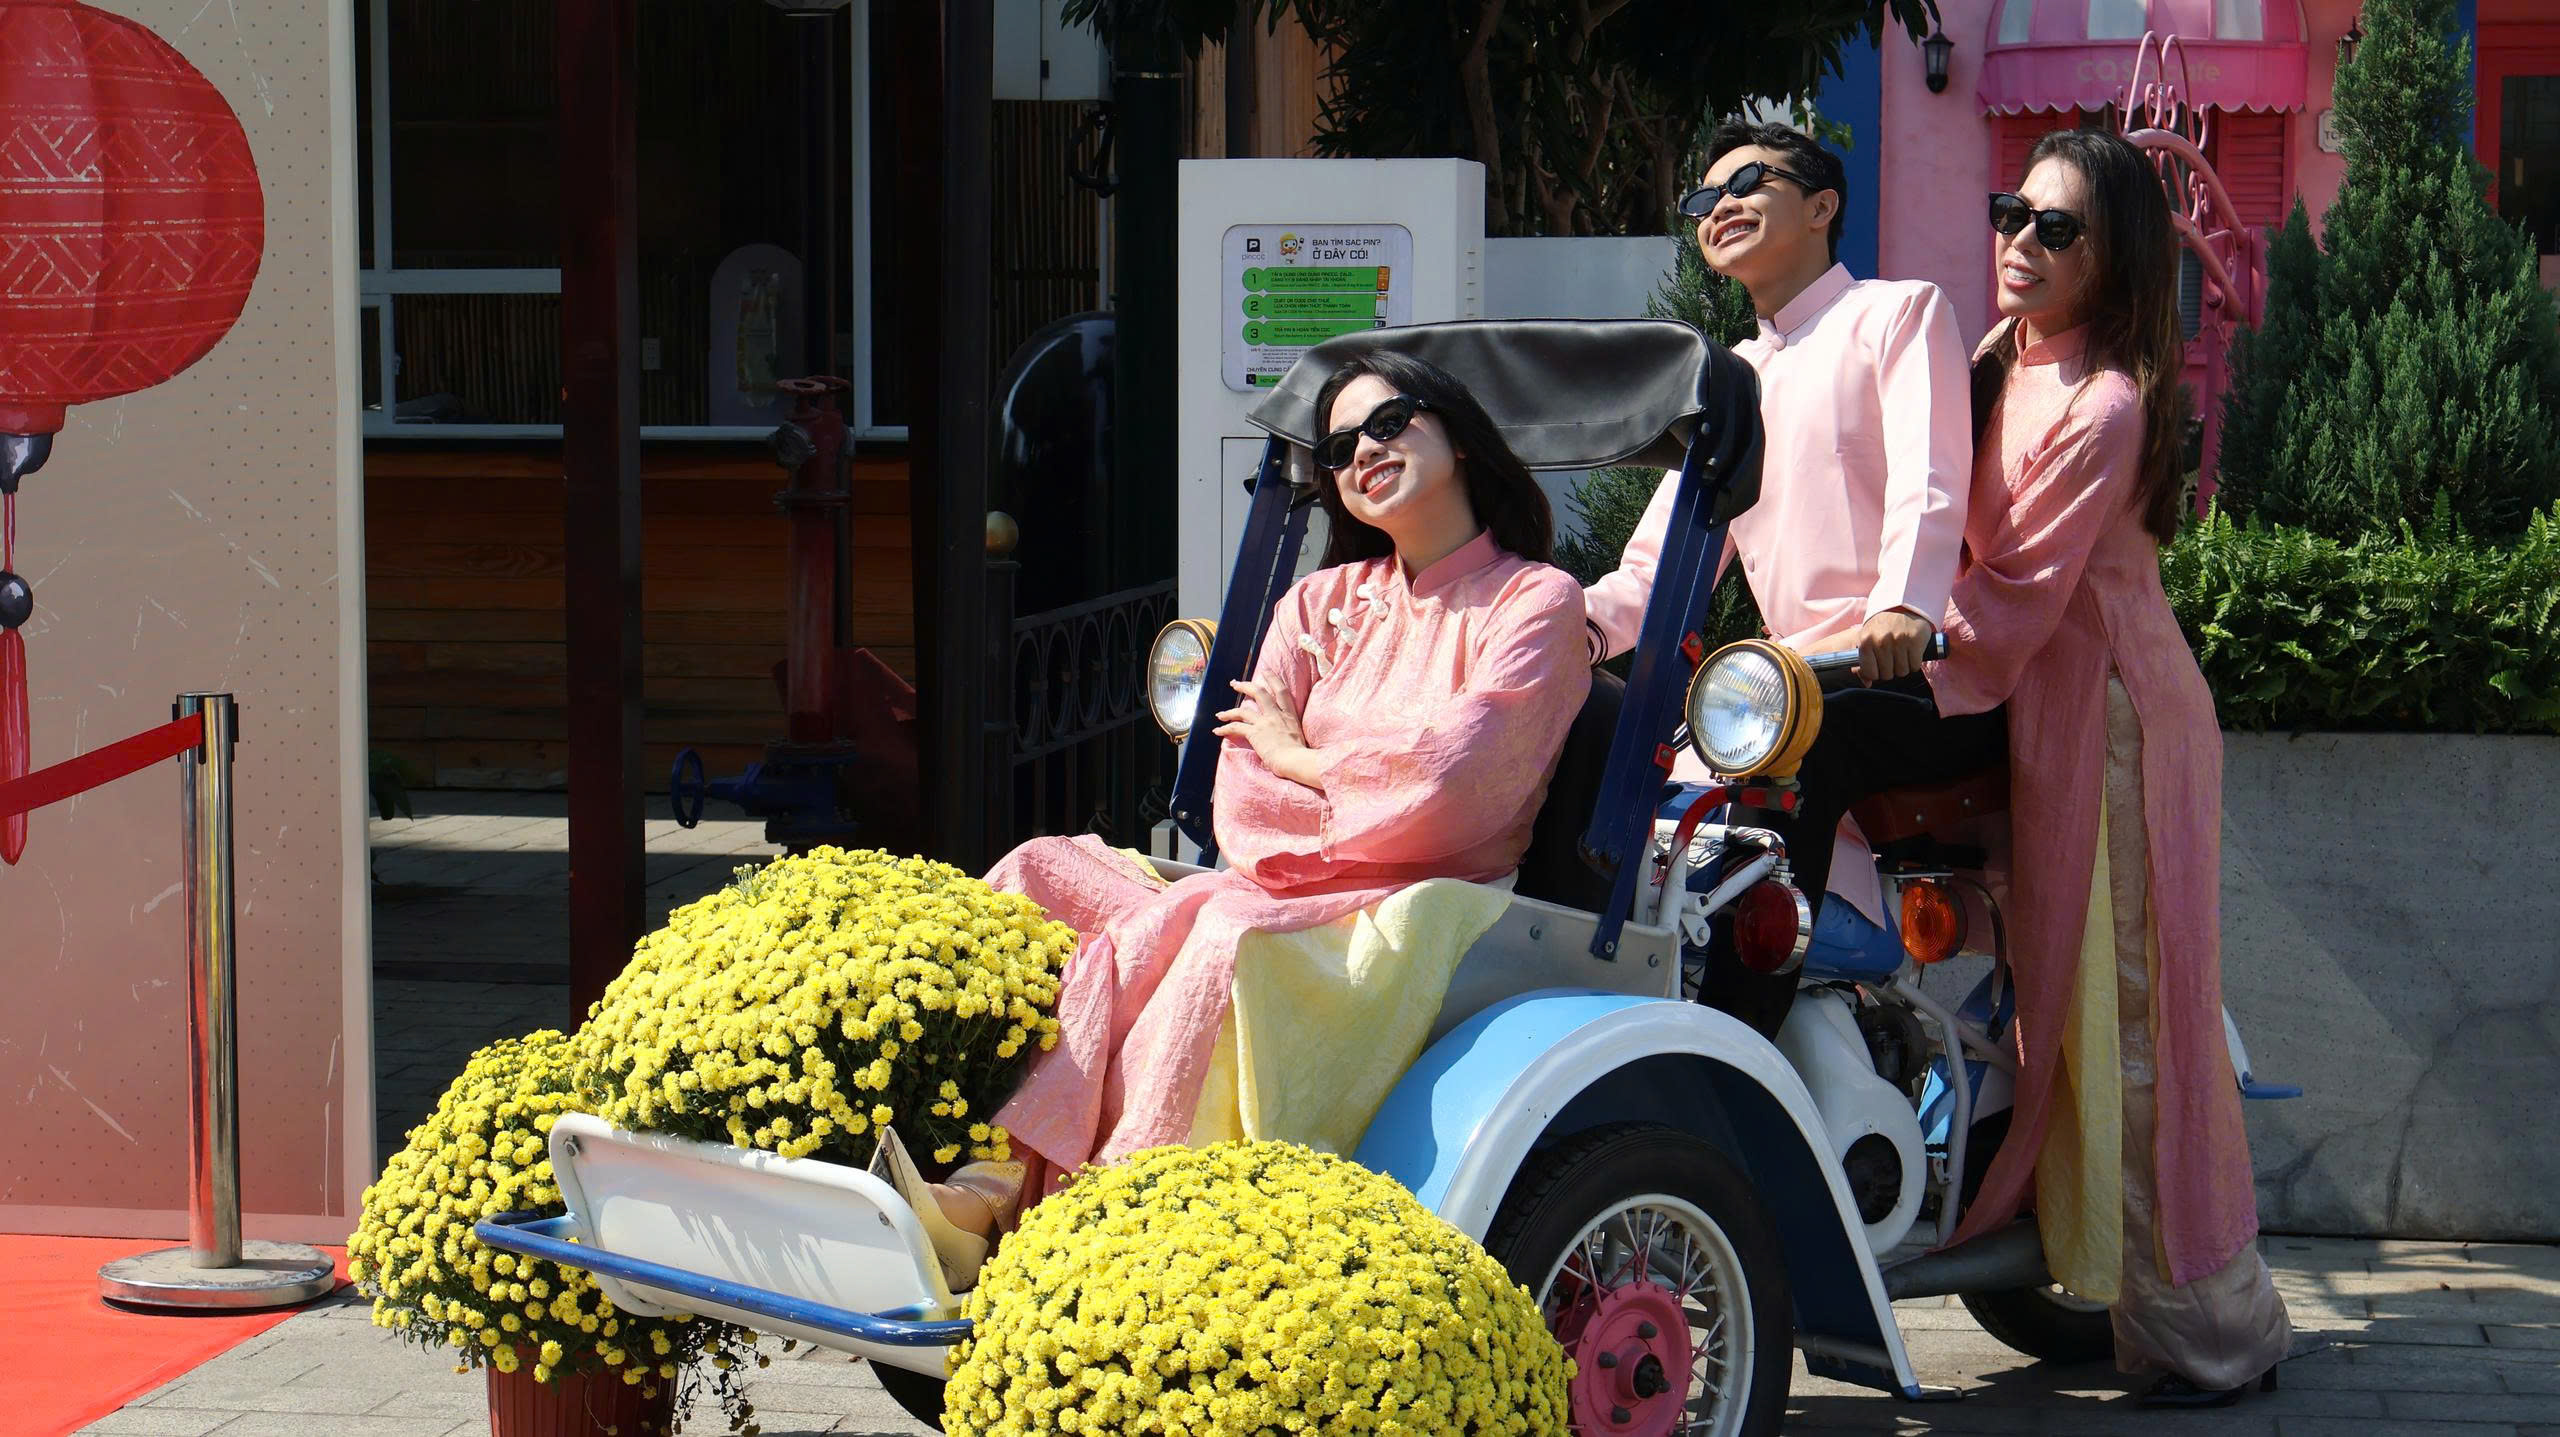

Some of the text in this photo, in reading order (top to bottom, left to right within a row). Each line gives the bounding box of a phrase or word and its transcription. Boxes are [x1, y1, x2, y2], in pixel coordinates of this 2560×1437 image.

[1324, 248, 1346, 259] ĐÂY
[1350, 248, 1368, 259] CÓ!
[1252, 273, 1257, 284] 1
[1250, 301, 1258, 311] 2
[1250, 328, 1258, 338] 3
